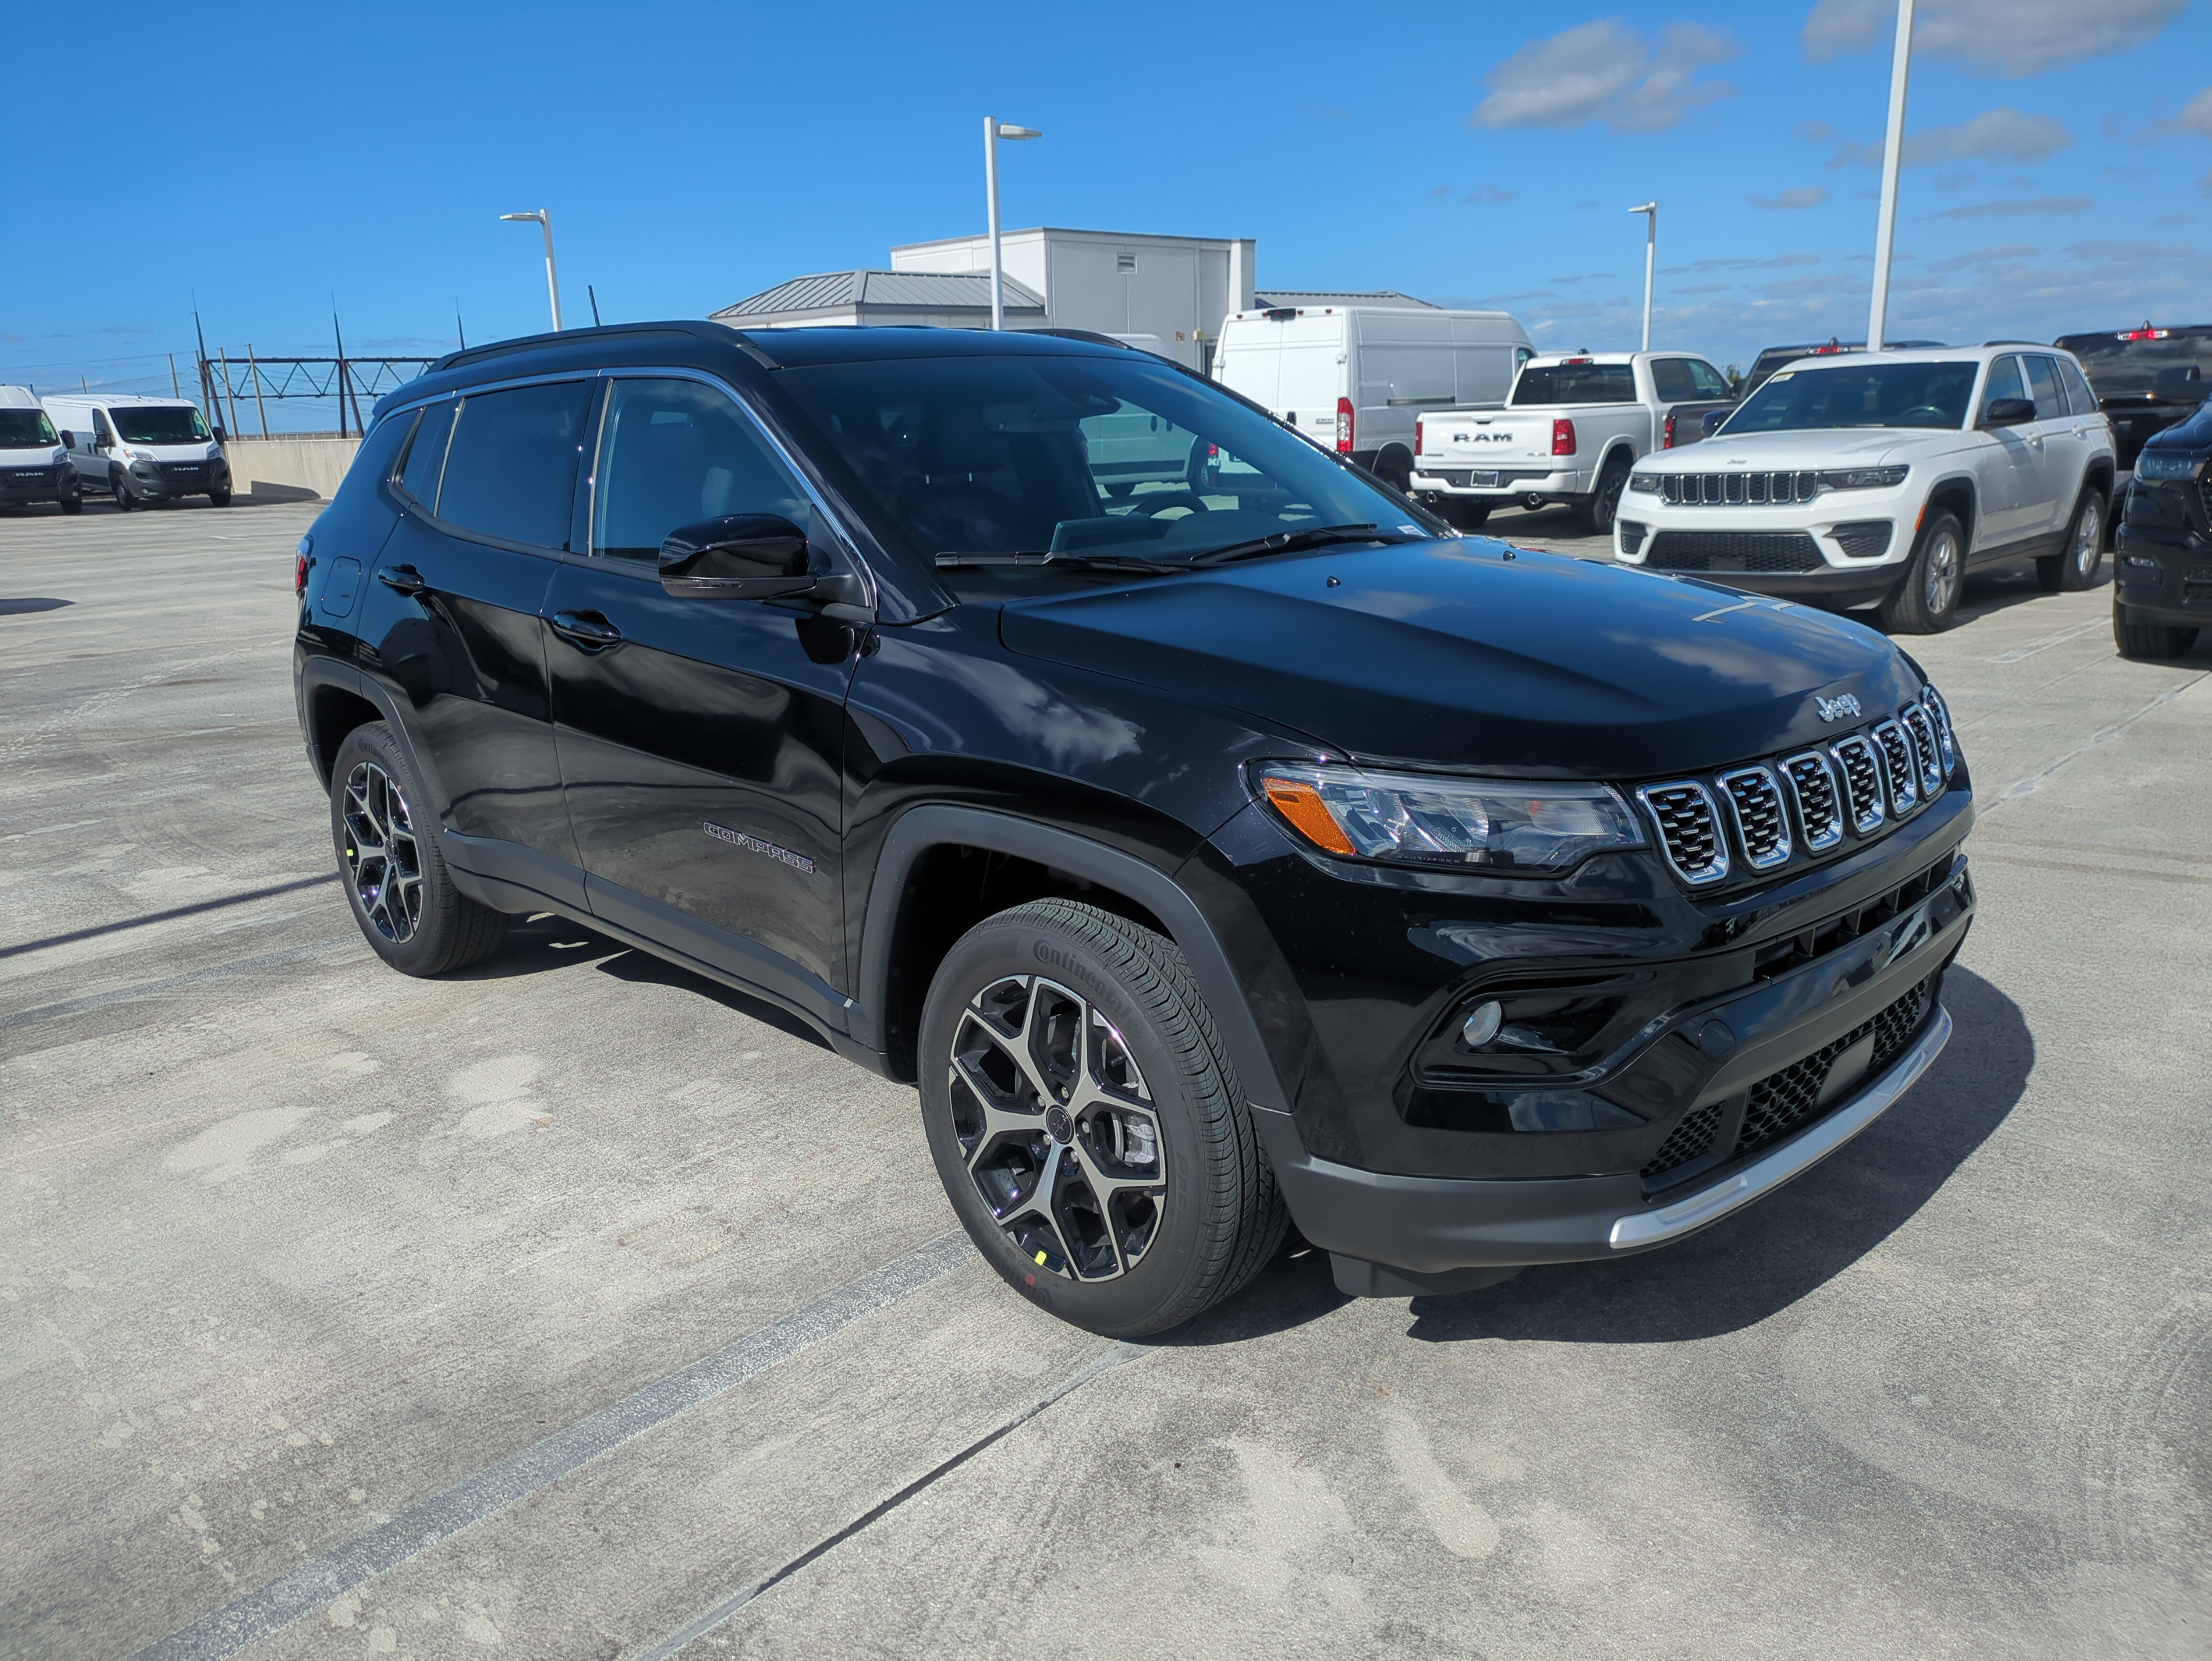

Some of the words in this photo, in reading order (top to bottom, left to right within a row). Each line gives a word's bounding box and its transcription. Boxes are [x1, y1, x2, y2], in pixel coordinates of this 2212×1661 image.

[1453, 433, 1513, 442] RAM
[1814, 692, 1861, 723] Jeep
[703, 821, 816, 874] COMPASS
[1032, 938, 1132, 1019] Continental
